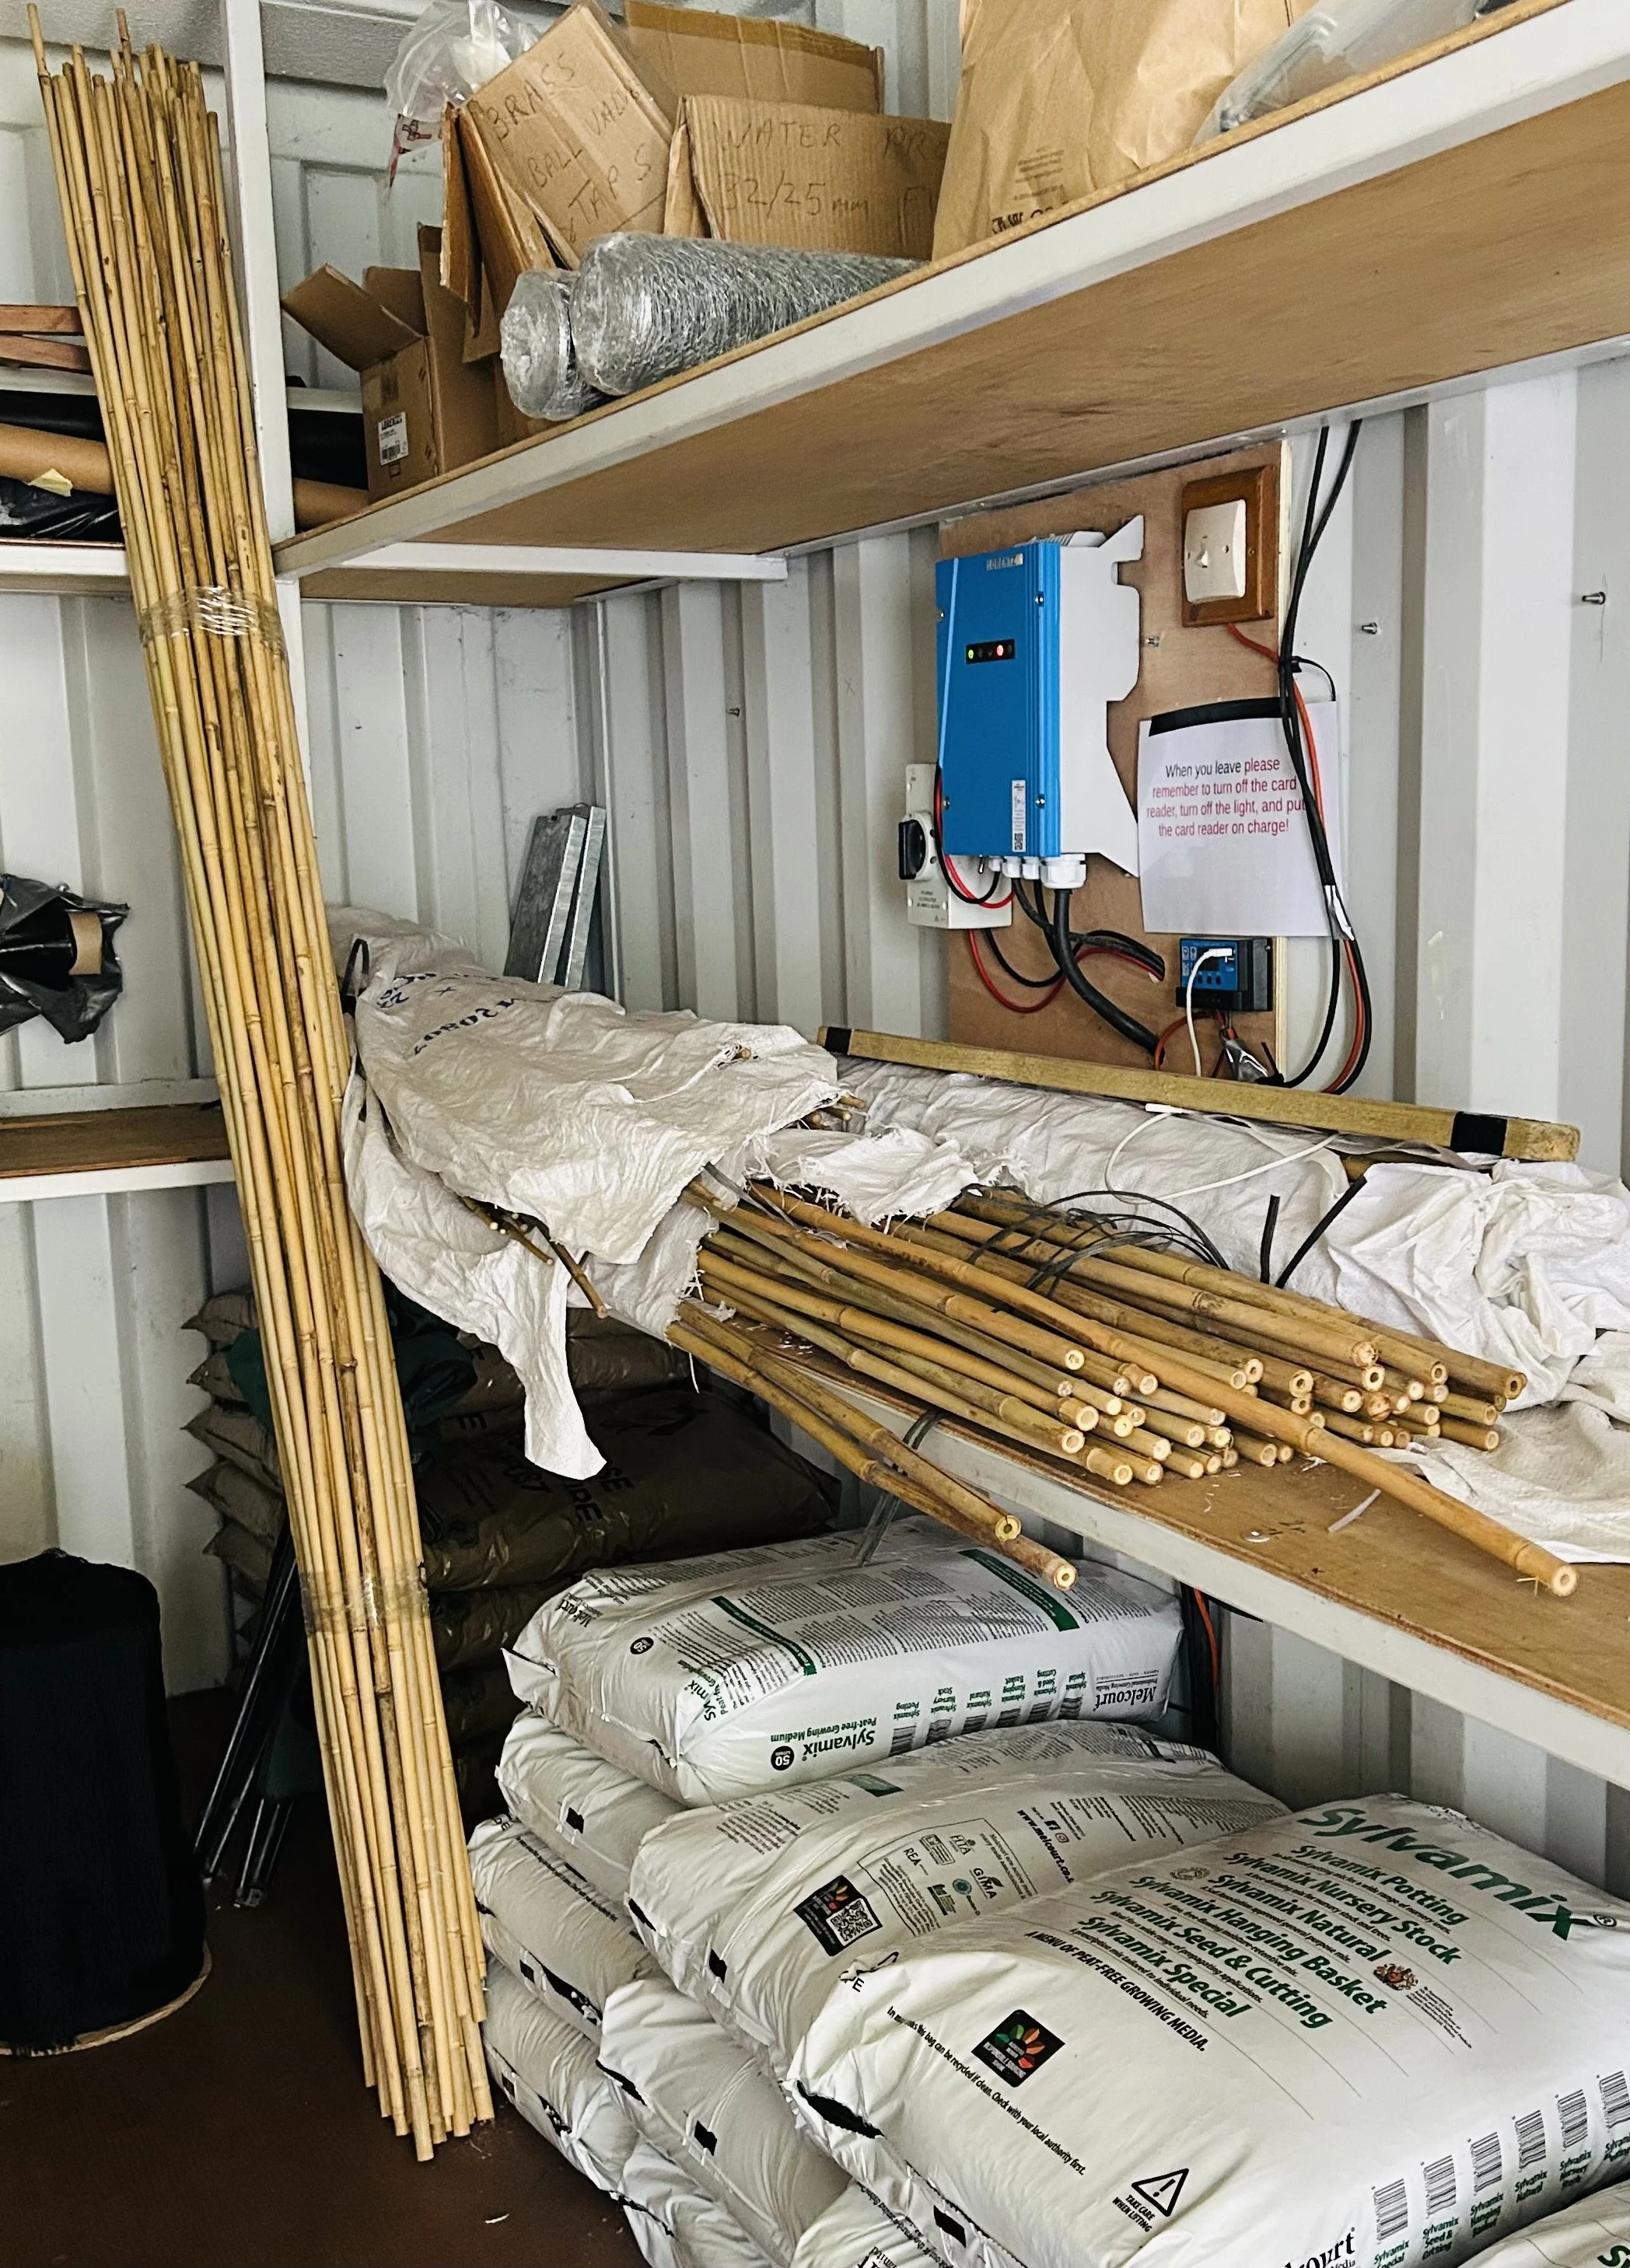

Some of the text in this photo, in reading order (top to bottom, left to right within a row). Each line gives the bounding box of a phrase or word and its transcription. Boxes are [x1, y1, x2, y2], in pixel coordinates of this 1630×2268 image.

[712, 118, 841, 152] WATER
[528, 149, 582, 188] BALL
[568, 143, 652, 225] TAPS
[1166, 757, 1279, 779] When you leave please
[1153, 783, 1198, 799] remember
[1213, 783, 1232, 795] turn
[1236, 779, 1248, 793] off
[1250, 779, 1268, 792] the
[1271, 776, 1297, 791] card
[1146, 797, 1306, 819] reader, turn off the light, and put
[1159, 819, 1289, 837] the card reader on charge!
[1095, 1686, 1157, 1711] Melcourt
[770, 1717, 877, 1742] Peat-free Growing Medium
[803, 1728, 875, 1757] Sylvamix
[774, 1755, 792, 1768] 50
[904, 1847, 922, 1866] REA
[973, 1868, 998, 1899] GIMA
[1290, 1845, 1471, 1926] Sylvamix Potting
[1296, 1807, 1600, 1941] Sylvamix
[1208, 1874, 1392, 1962] Sylvamix Natural
[1222, 1852, 1462, 1965] Sylvamix Nursery Stock
[1090, 1890, 1333, 2029] Sylvamix Seed & Cutting
[1129, 1875, 1388, 2015] Sylvamix Hanging Basket
[1078, 1916, 1253, 2018] Sylvamix Special
[1034, 1932, 1066, 1948] MENU
[1060, 1942, 1078, 1955] OF
[1071, 1949, 1128, 1985] PEAT-FREE
[1120, 1980, 1177, 2029] GROWING
[1167, 2018, 1210, 2052] MEDIA.
[924, 2032, 936, 2048] bag
[934, 2043, 946, 2054] can
[943, 2049, 953, 2061] be
[950, 2057, 976, 2082] recycled
[992, 2092, 1010, 2110] Check
[1006, 2103, 1022, 2120] with
[1016, 2116, 1034, 2132] your
[1031, 2125, 1050, 2142] local
[1044, 2137, 1073, 2165] authority
[1069, 2158, 1086, 2175] first.
[1112, 2196, 1153, 2232] WHEN LIFTING
[1125, 2194, 1156, 2222] TAKE CARE
[1373, 2239, 1409, 2265] Sylvamix
